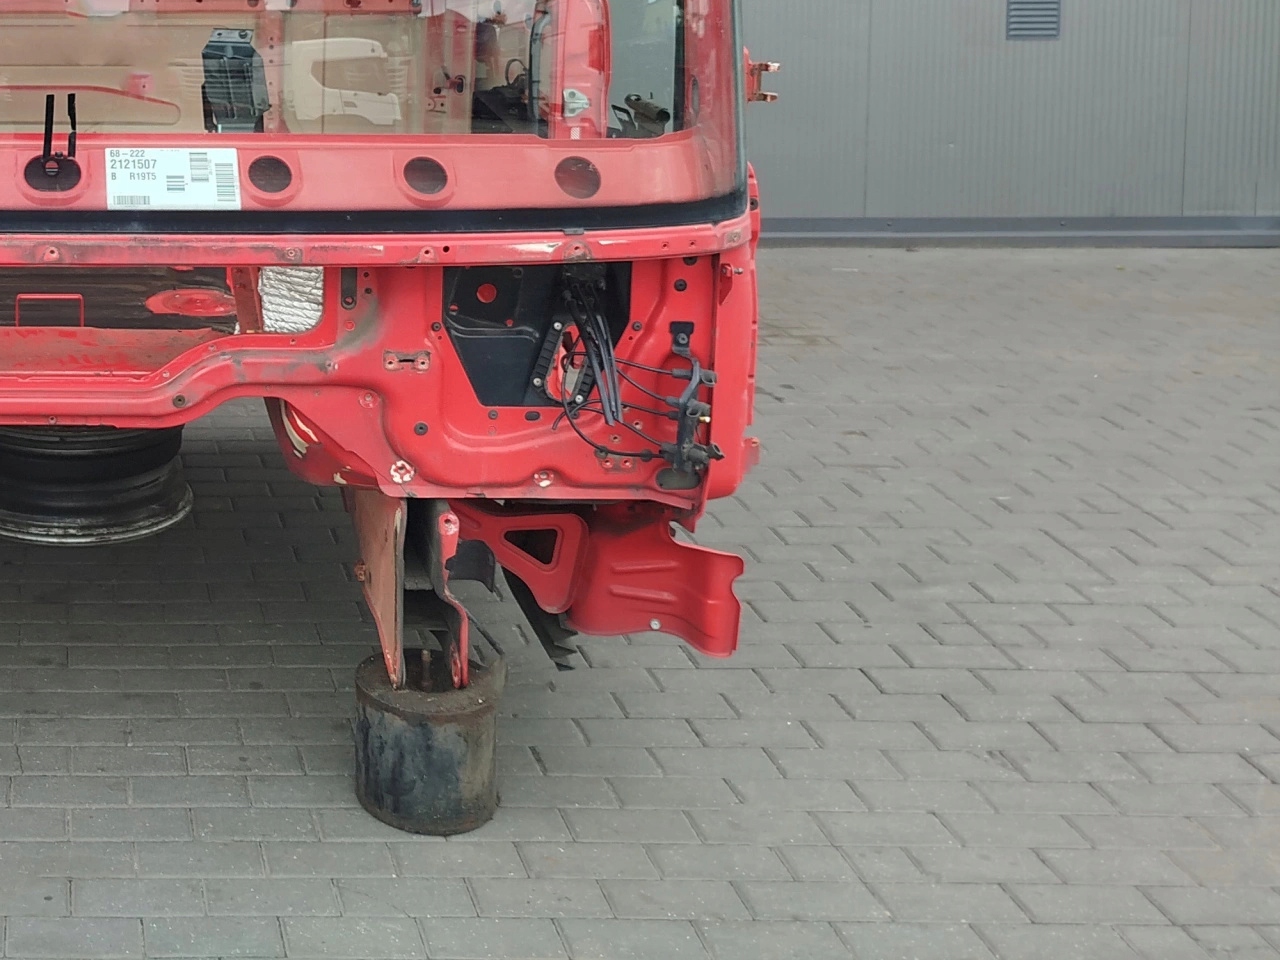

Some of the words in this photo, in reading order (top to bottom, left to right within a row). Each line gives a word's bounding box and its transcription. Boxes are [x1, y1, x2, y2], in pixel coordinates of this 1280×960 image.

[110, 159, 157, 169] 2121507
[111, 172, 117, 181] B
[130, 172, 157, 181] R19T5
